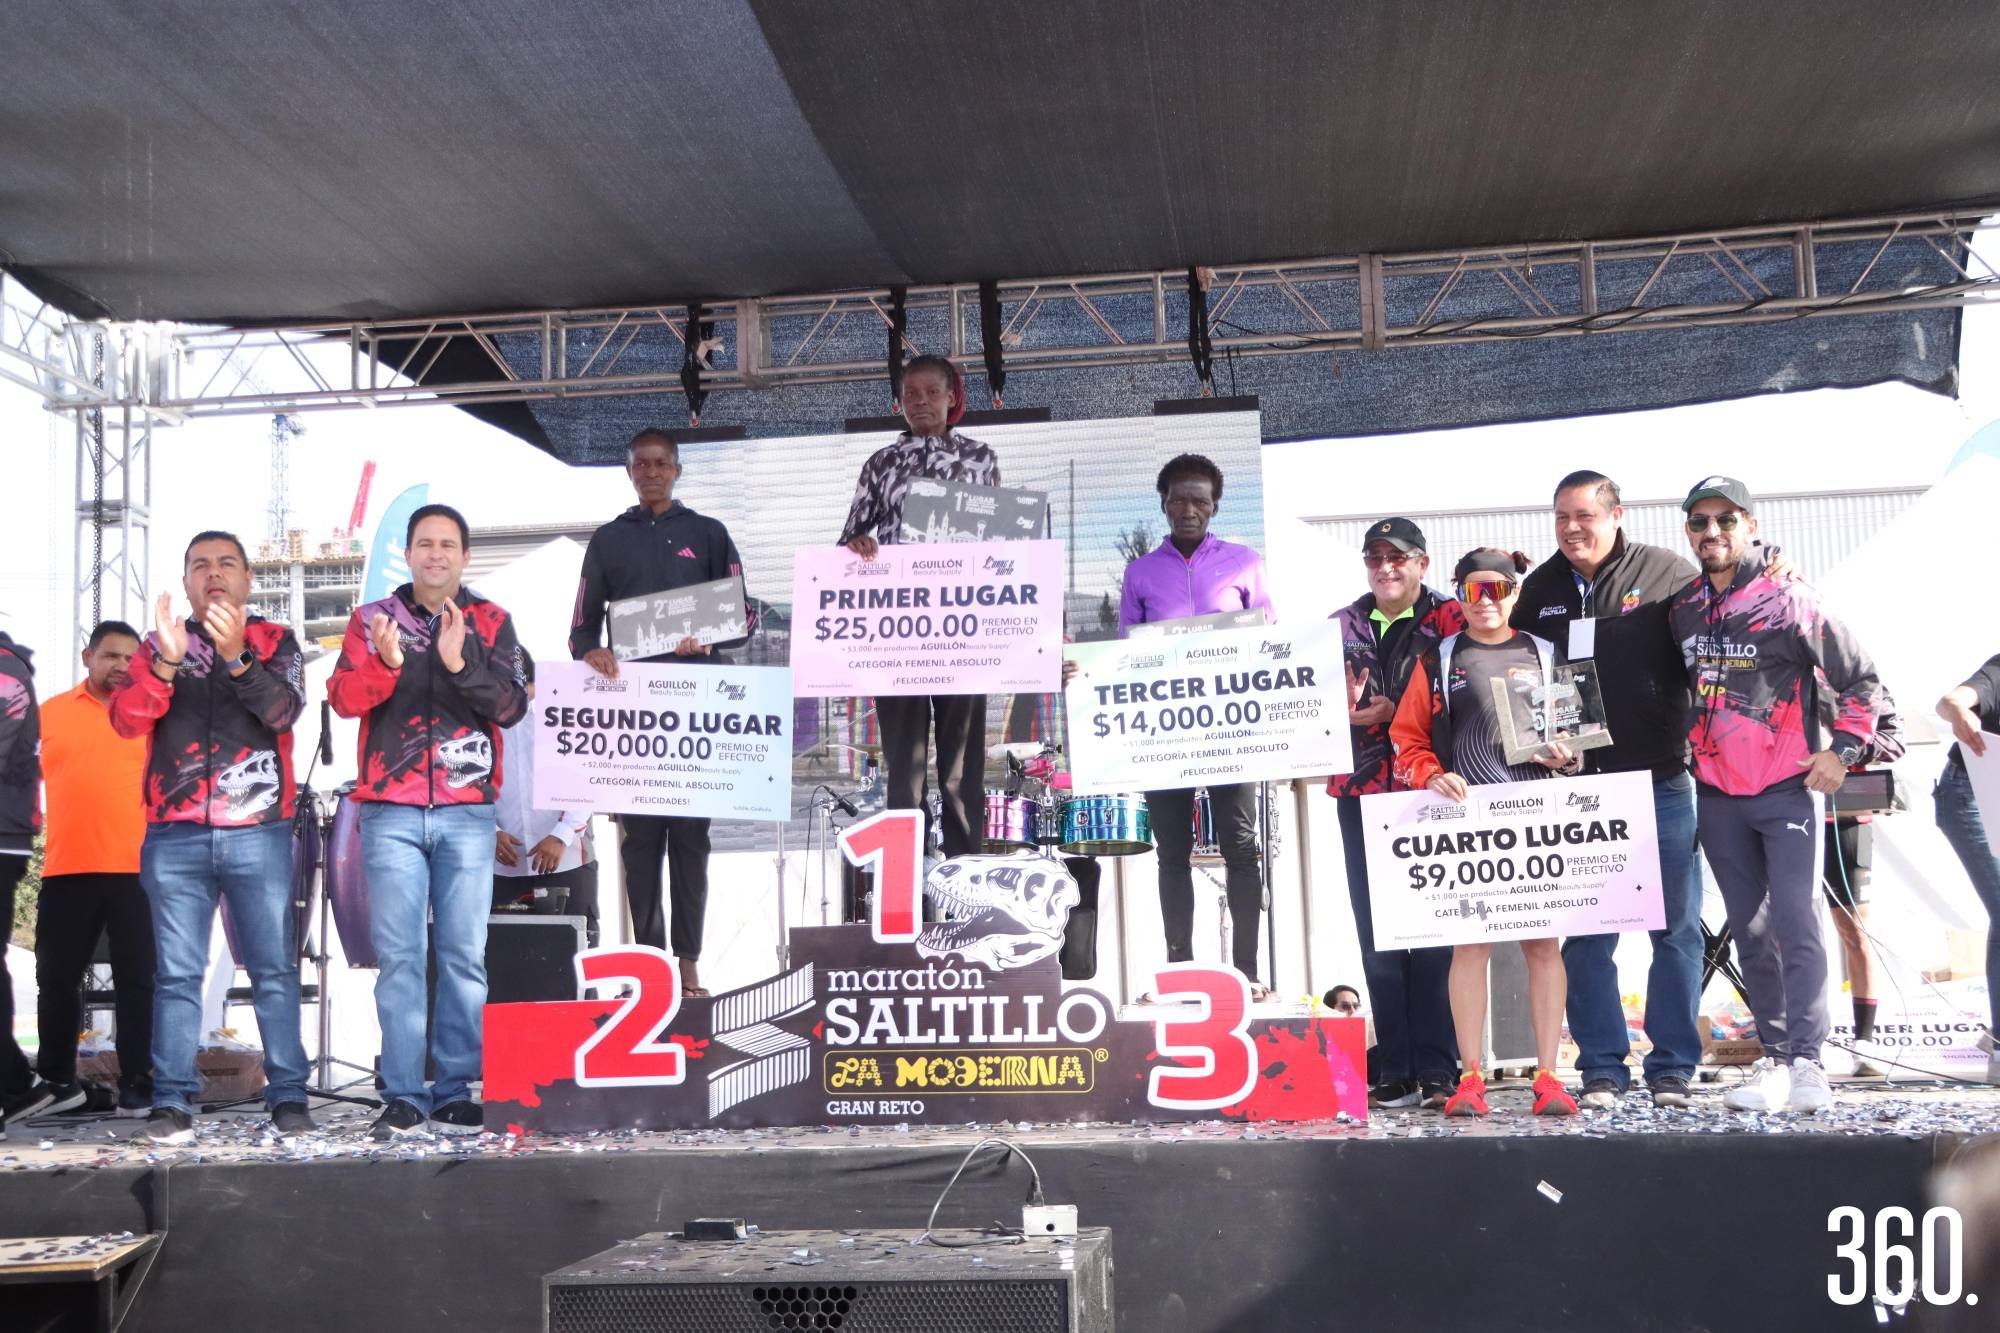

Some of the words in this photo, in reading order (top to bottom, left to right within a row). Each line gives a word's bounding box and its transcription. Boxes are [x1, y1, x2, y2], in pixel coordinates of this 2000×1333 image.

[911, 558, 963, 569] AGUILLÓN
[819, 587, 931, 610] PRIMER
[939, 584, 1039, 607] LUGAR
[815, 614, 978, 643] $25,000.00
[982, 617, 1021, 627] PREMIO
[1024, 616, 1038, 625] EN
[985, 626, 1034, 636] EFECTIVO
[1186, 646, 1238, 659] AGUILLÓN
[848, 658, 903, 669] CATEGORÍA
[905, 658, 947, 668] FEMENIL
[949, 657, 1001, 667] ABSOLUTO
[648, 679, 697, 690] AGUILLÓN
[892, 676, 955, 686] ¡FELICIDADES!
[1094, 675, 1207, 706] TERCER
[1215, 666, 1316, 696] LUGAR
[1699, 685, 1726, 697] VIP
[1264, 700, 1305, 712] PREMIO
[1307, 699, 1322, 708] EN
[544, 706, 681, 732] SEGUNDO
[689, 712, 783, 737] LUGAR
[1093, 700, 1261, 738] $14,000.00
[1269, 708, 1319, 722] EFECTIVO
[556, 729, 713, 761] $20,000.00
[715, 742, 753, 753] PREMIO
[755, 743, 769, 753] EN
[718, 752, 765, 763] EFECTIVO
[1132, 751, 1188, 764] CATEGORÍA
[1190, 748, 1234, 759] FEMENIL
[1236, 743, 1289, 755] ABSOLUTO
[1180, 764, 1243, 779] ¡FELICIDADES!
[589, 776, 641, 787] CATEGORÍA
[643, 779, 683, 789] FEMENIL
[685, 781, 734, 791] ABSOLUTO
[631, 795, 691, 806] ¡FELICIDADES!
[1489, 797, 1544, 811] AGUILLÓN
[1431, 805, 1467, 815] SALTILLO
[1491, 807, 1517, 818] Beauty
[1518, 807, 1544, 817] Supply
[1392, 827, 1518, 859] CUARTO
[1525, 819, 1630, 848] LUGAR
[1567, 854, 1609, 866] PREMIO
[1611, 853, 1627, 863] EN
[841, 811, 922, 940] 1
[1408, 853, 1565, 891] $9,000.00
[1571, 863, 1624, 876] EFECTIVO
[1470, 888, 1508, 900] productos
[1435, 904, 1493, 918] CATEOA
[1496, 901, 1540, 913] FEMENIL
[1543, 897, 1598, 909] ABSOLUTO
[1485, 919, 1551, 933] ¡FELICIDADES!
[828, 960, 985, 992] maratón
[577, 948, 681, 1084] 2
[825, 994, 1107, 1045] SALTILLO
[1922, 1023, 1988, 1033] LUGA
[1150, 966, 1256, 1107] 3
[831, 1057, 882, 1088] LA
[896, 1055, 1086, 1087] MODERNA
[826, 1100, 875, 1115] GRAN
[879, 1099, 925, 1115] RETO
